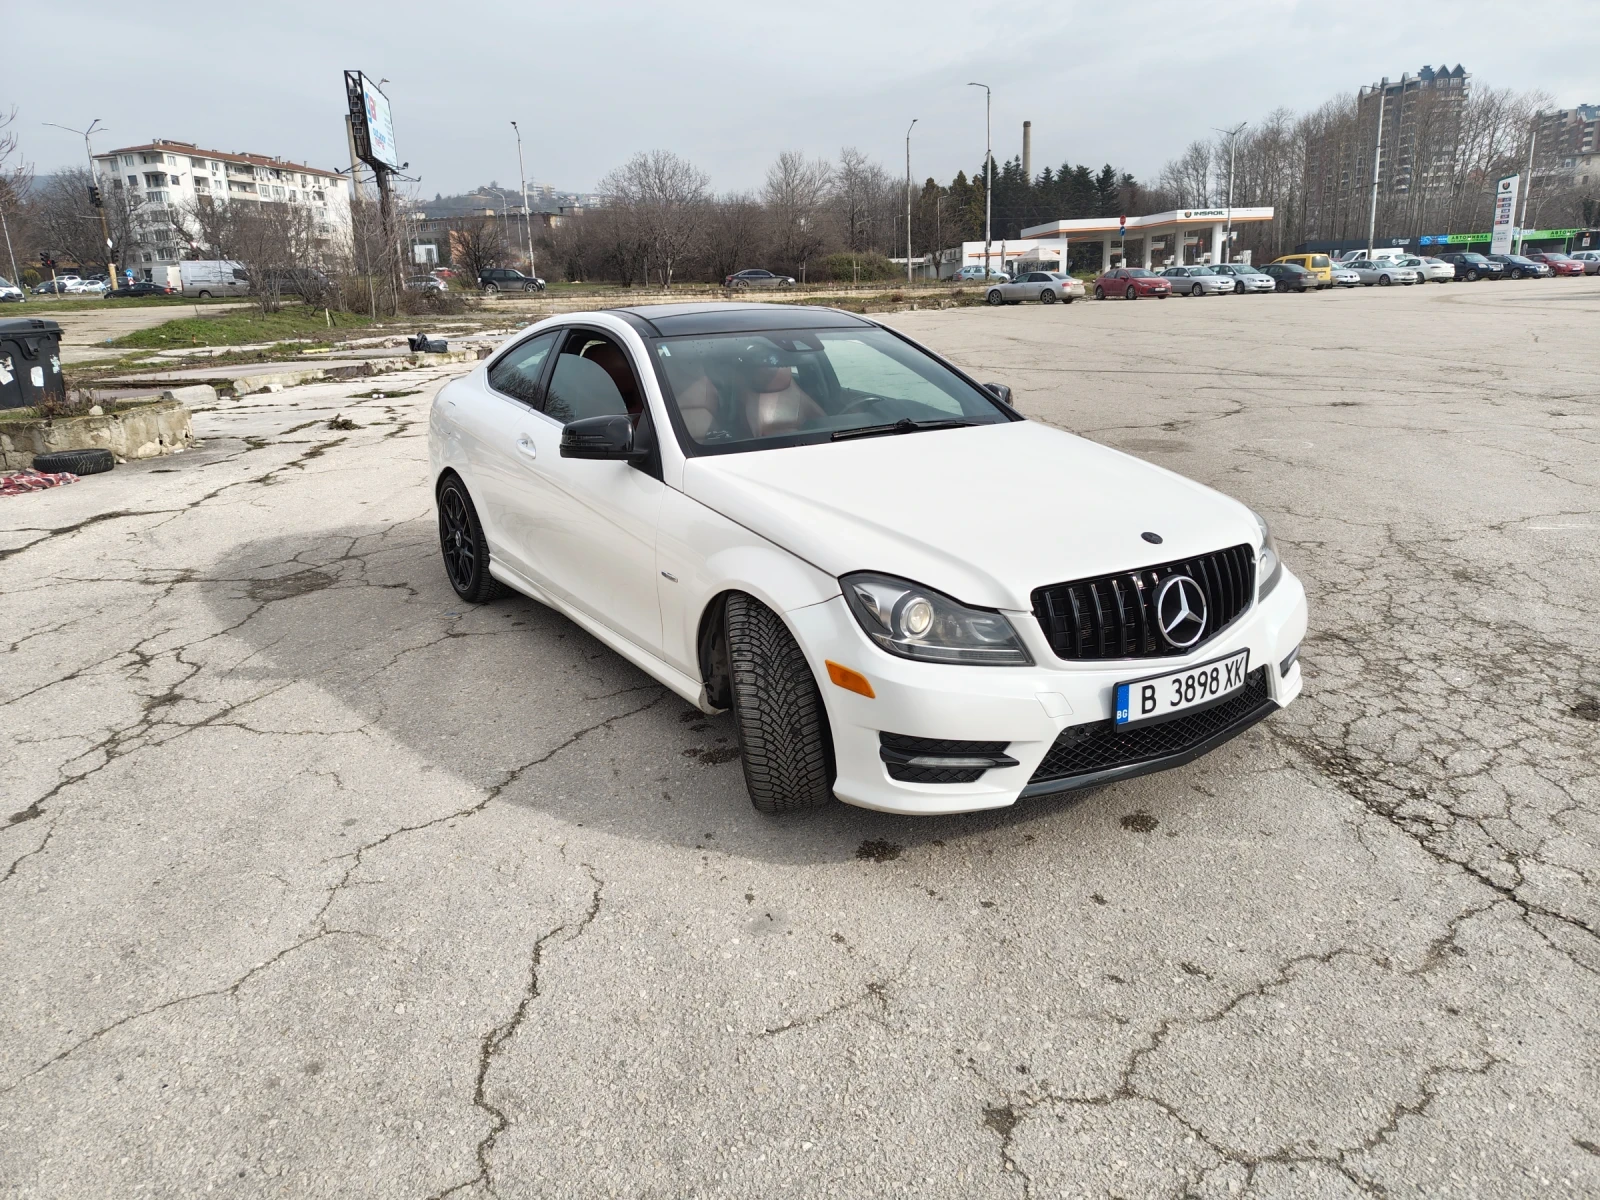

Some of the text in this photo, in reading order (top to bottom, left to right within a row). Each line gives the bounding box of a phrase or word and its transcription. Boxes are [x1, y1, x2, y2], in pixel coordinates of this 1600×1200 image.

[1141, 656, 1245, 715] B 3898 XK
[1116, 710, 1128, 720] BG
